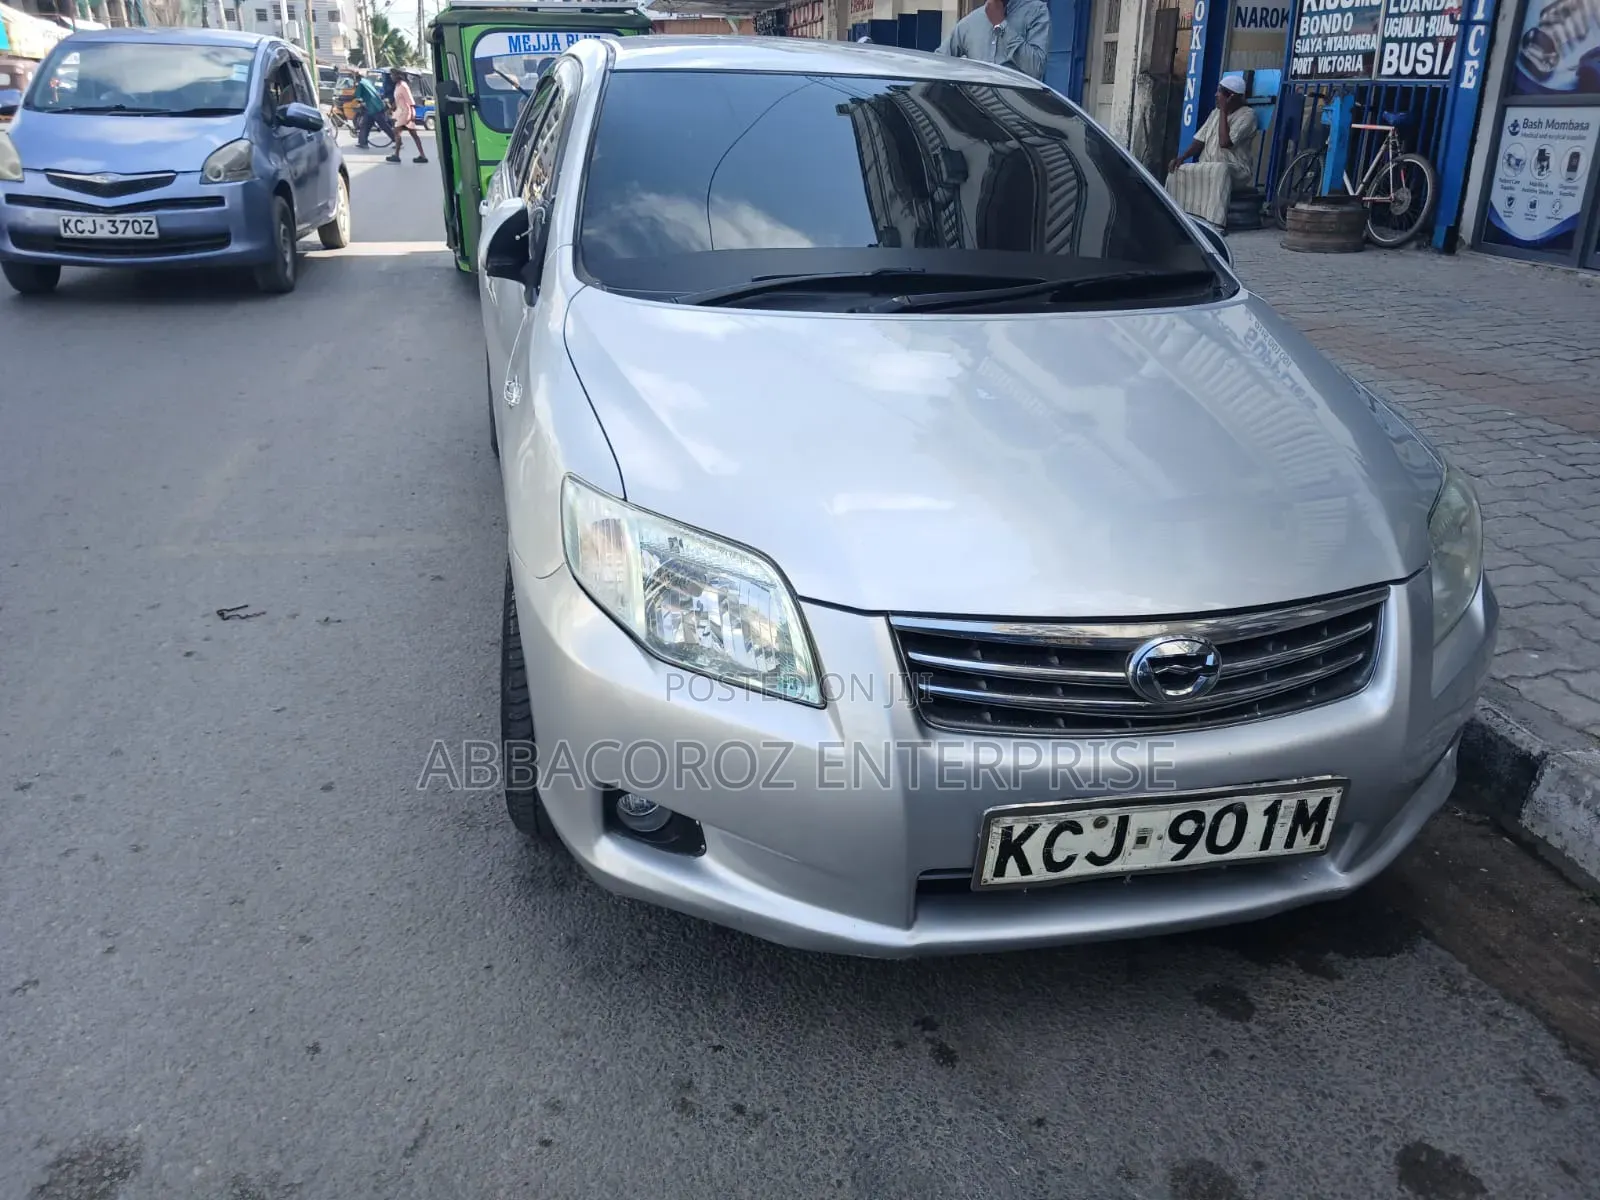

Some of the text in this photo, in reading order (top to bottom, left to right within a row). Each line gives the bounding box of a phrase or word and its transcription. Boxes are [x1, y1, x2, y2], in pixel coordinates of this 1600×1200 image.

[1235, 6, 1290, 28] NAROK
[1299, 12, 1354, 37] BONDO
[508, 33, 562, 54] MEJJA
[1292, 55, 1364, 75] PORT VICTORIA
[1522, 118, 1590, 131] Bash Mombasa
[62, 218, 155, 235] KCJ 370Z
[993, 796, 1333, 877] KCJ 901M
